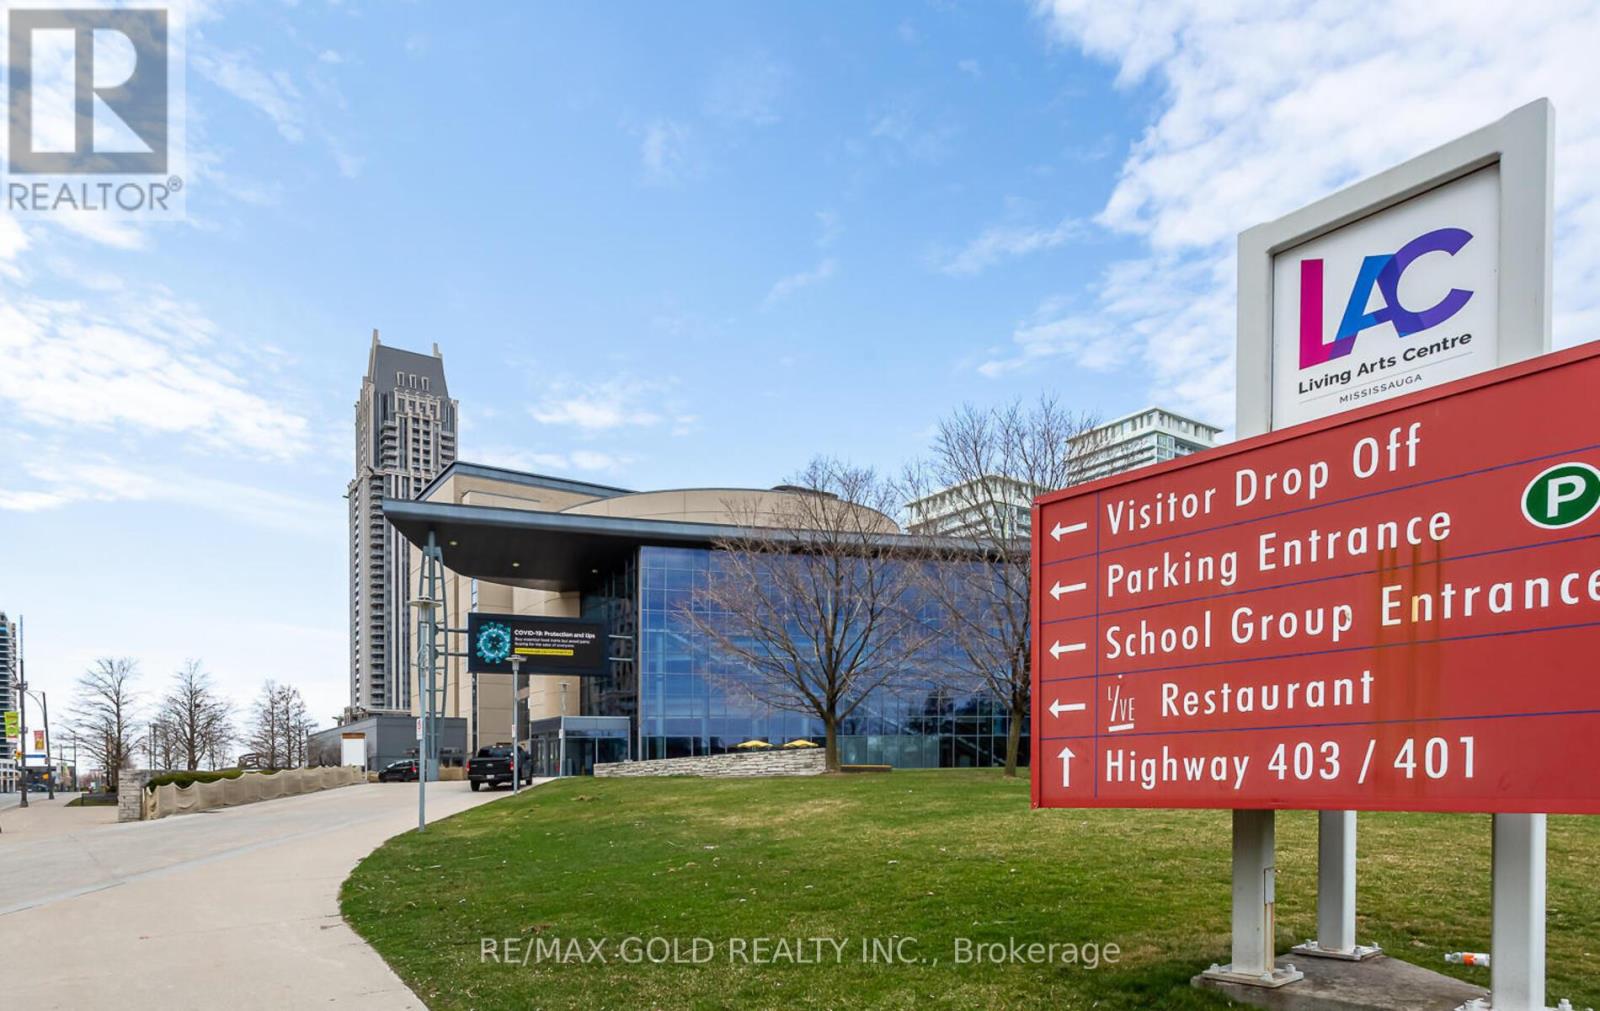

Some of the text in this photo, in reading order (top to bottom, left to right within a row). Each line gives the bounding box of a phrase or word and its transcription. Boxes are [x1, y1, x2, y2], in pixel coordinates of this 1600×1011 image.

[1299, 228, 1474, 370] LAC
[1298, 332, 1472, 395] Living Arts Centre
[1339, 374, 1422, 404] MISSISSAUGA
[1106, 421, 1422, 535] Visitor Drop Off
[1546, 474, 1587, 519] P
[1107, 511, 1451, 598] Parking Entrance
[1106, 610, 1211, 660] School
[1231, 604, 1353, 644] Group
[1161, 670, 1375, 717] Restaurant
[1106, 735, 1474, 791] Highway 403 / 401
